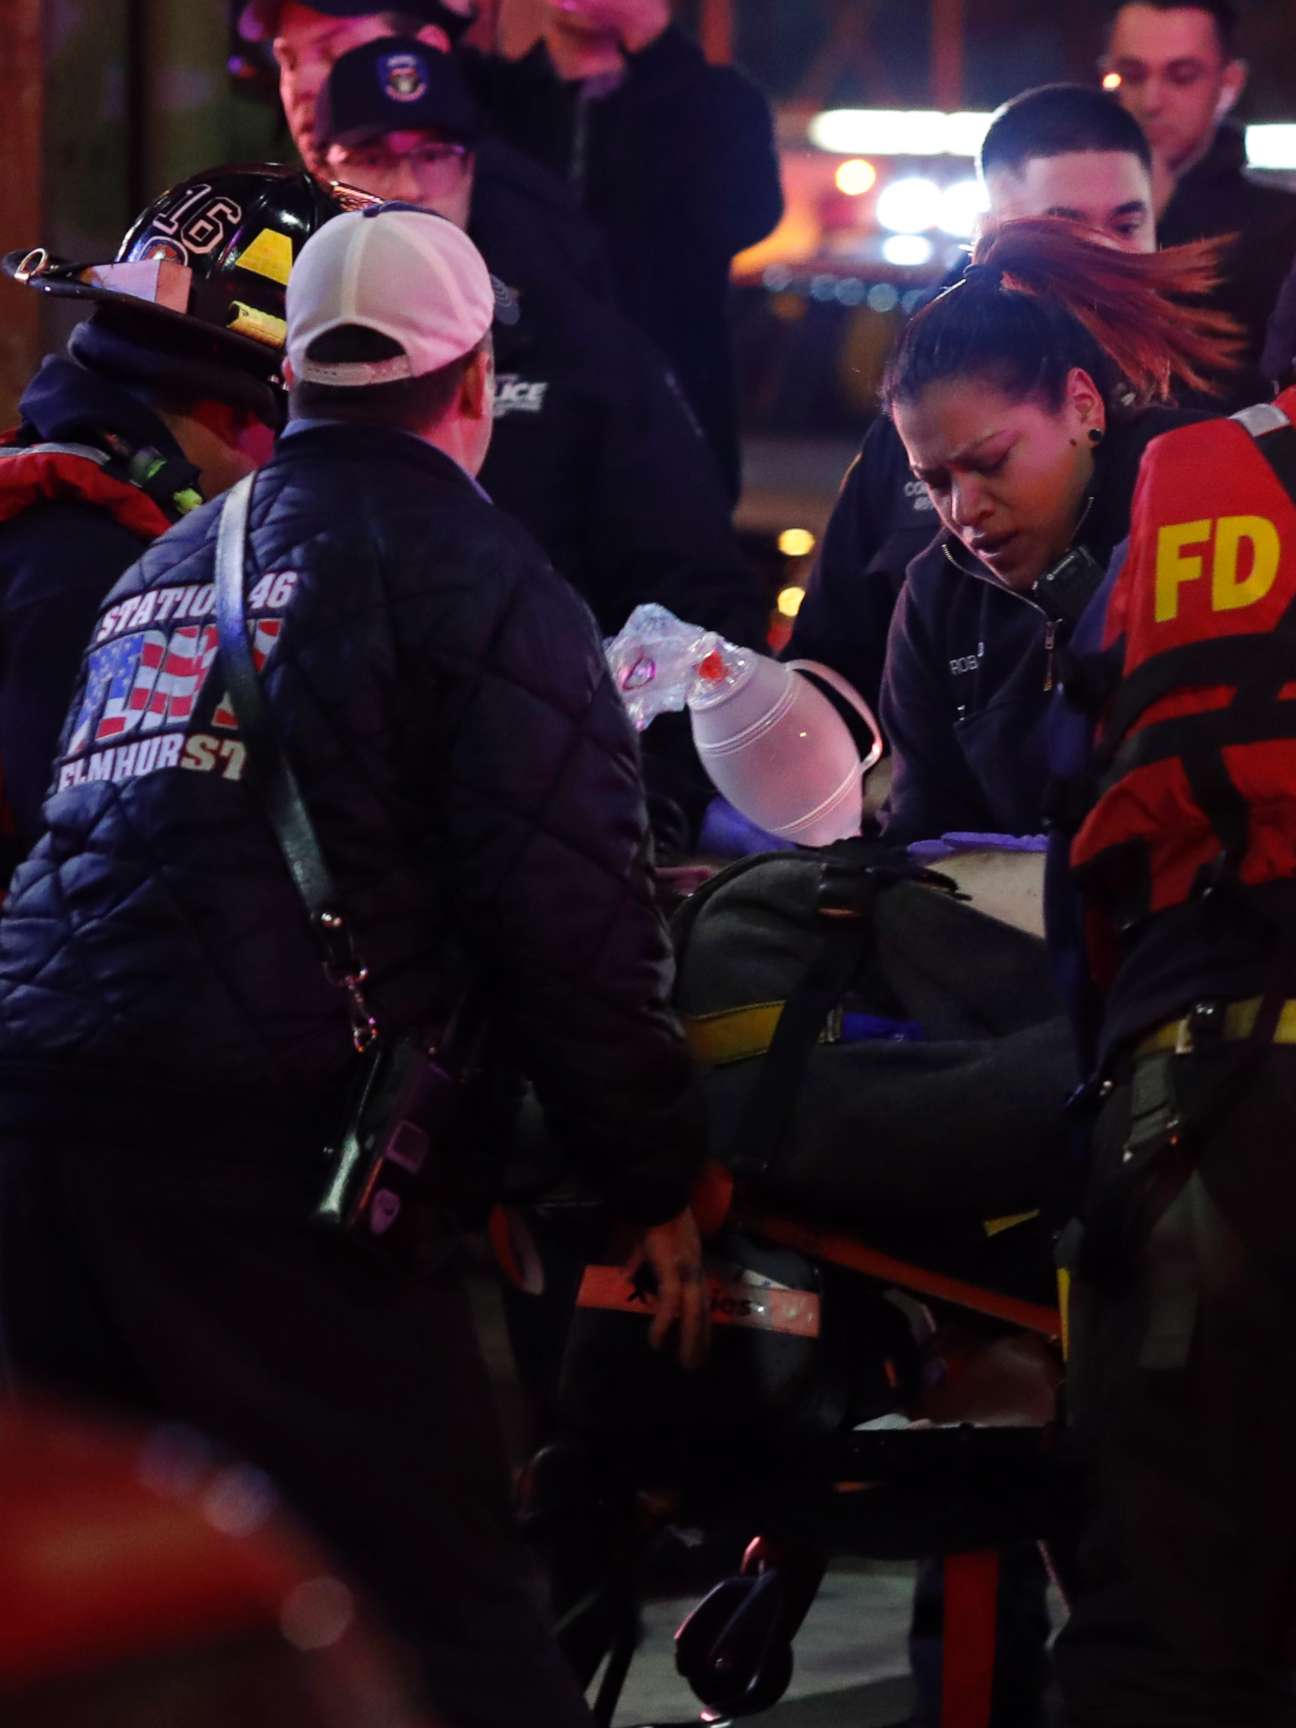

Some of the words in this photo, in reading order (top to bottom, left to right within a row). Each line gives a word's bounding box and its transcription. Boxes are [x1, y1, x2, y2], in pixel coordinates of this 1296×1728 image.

[152, 183, 243, 255] 16
[1153, 514, 1282, 625] FD
[96, 582, 217, 643] STATIO
[249, 571, 298, 610] 46
